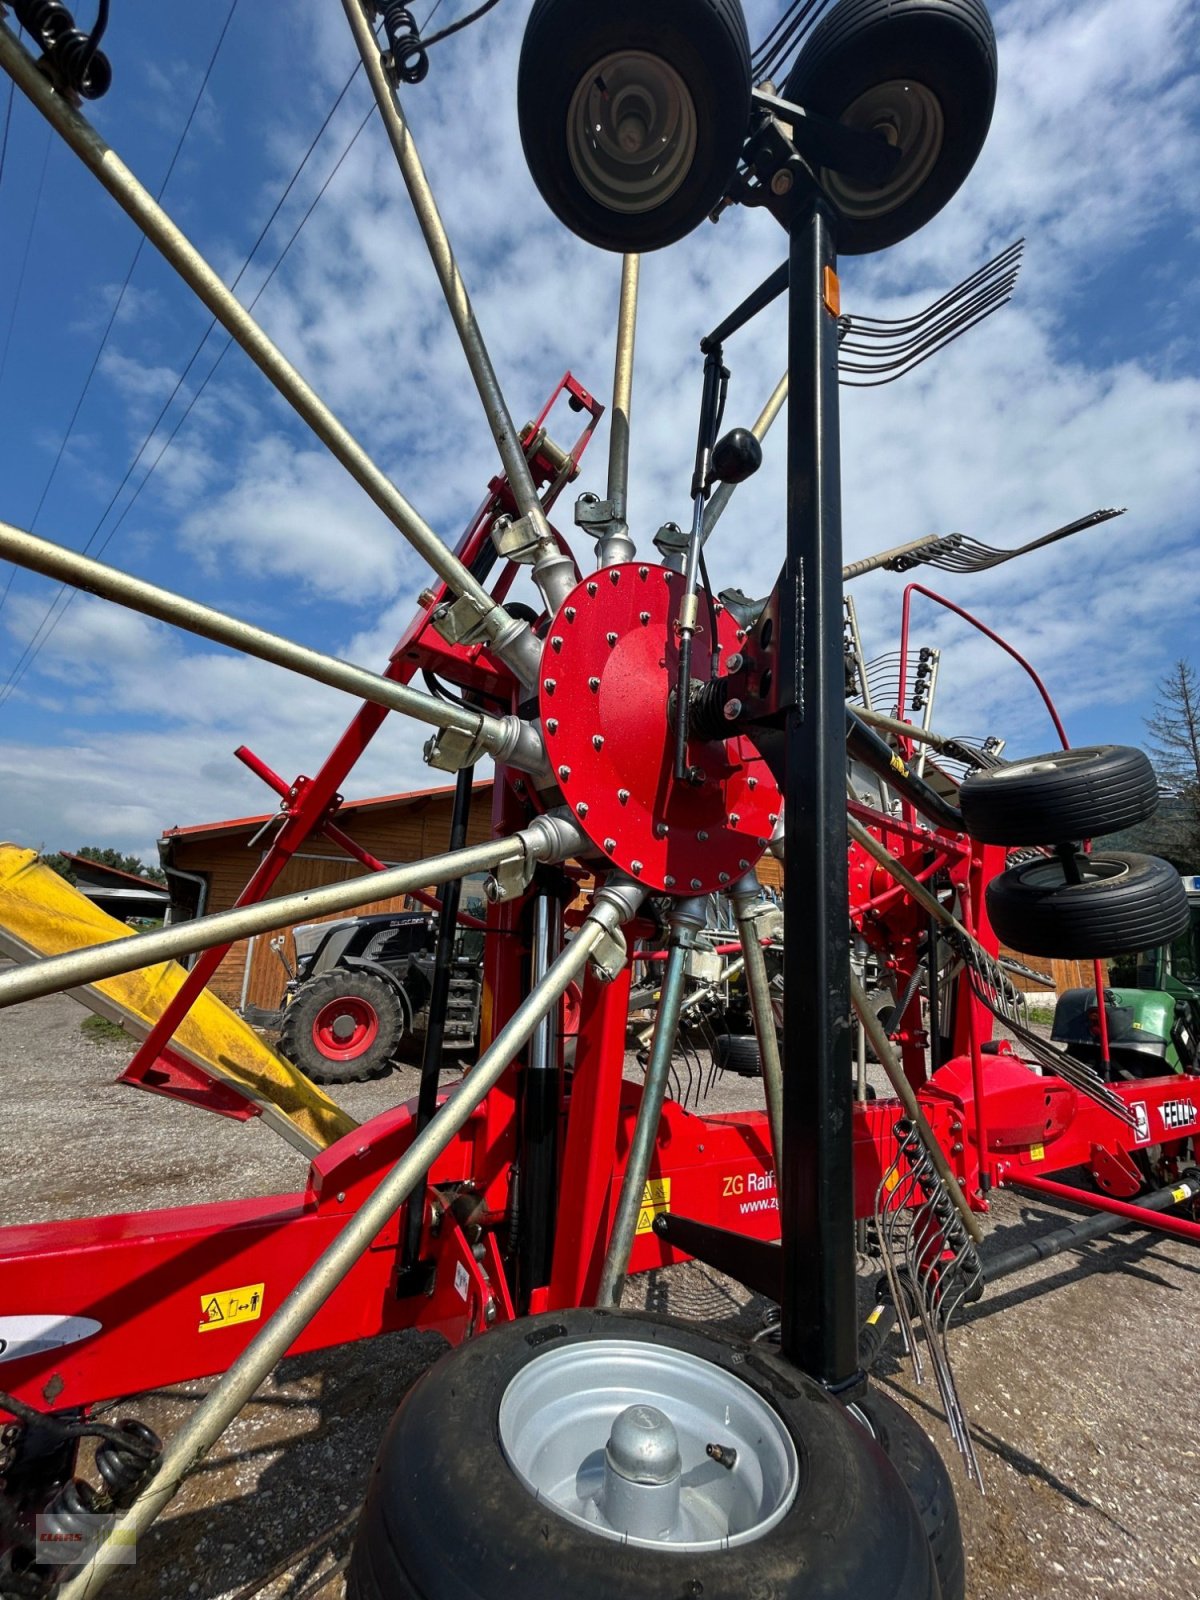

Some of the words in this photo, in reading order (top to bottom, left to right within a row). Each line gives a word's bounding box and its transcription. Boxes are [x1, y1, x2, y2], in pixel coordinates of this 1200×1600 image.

[1163, 1098, 1196, 1130] FELLA
[722, 1174, 744, 1196] ZG
[747, 1170, 777, 1192] Raif
